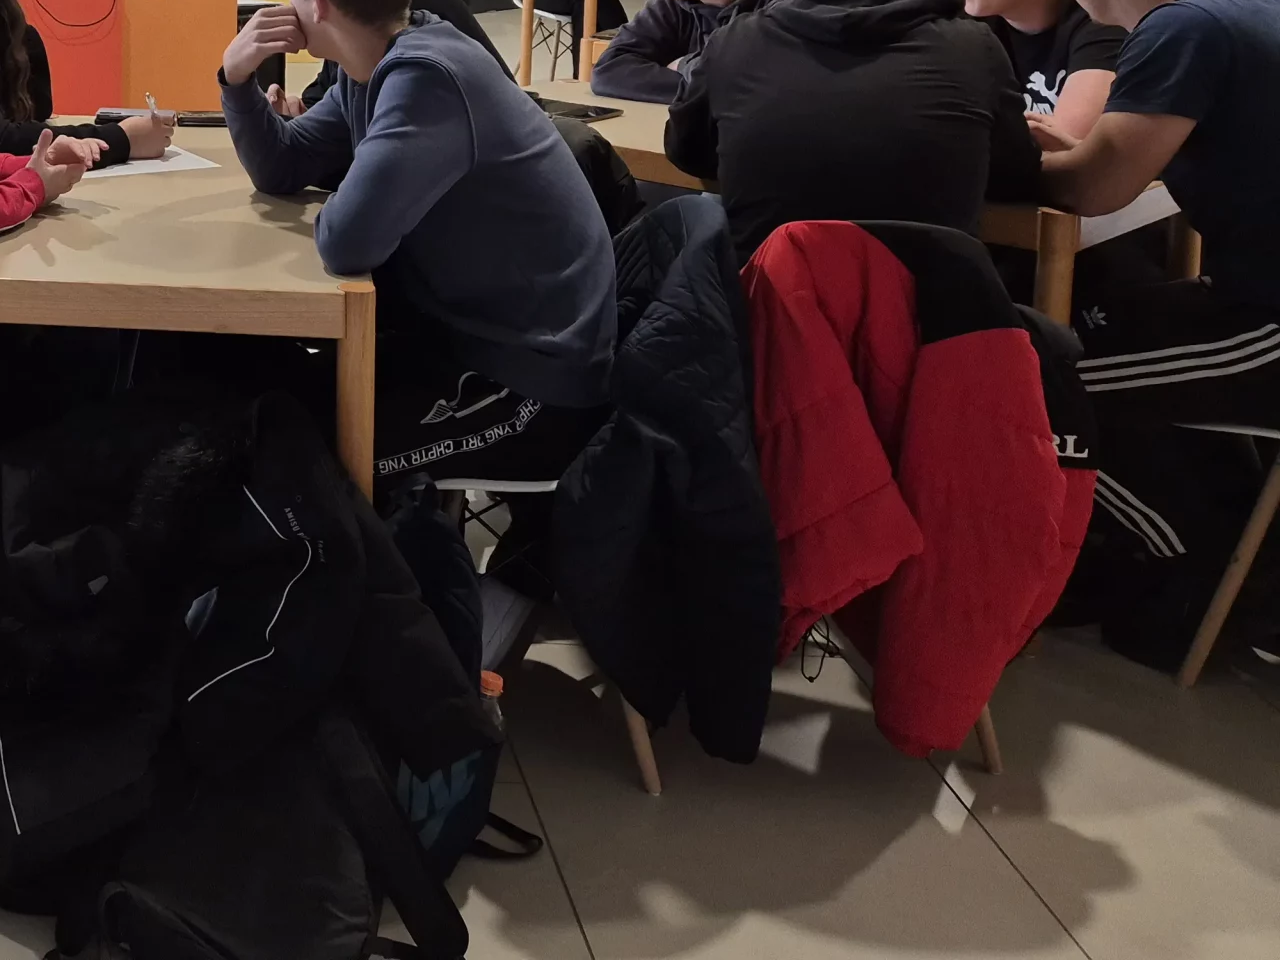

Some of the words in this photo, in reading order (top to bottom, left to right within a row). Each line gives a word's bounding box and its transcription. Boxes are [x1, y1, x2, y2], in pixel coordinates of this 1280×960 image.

[485, 423, 512, 443] YNG
[410, 440, 454, 465] CHPTR
[379, 456, 409, 474] YNG
